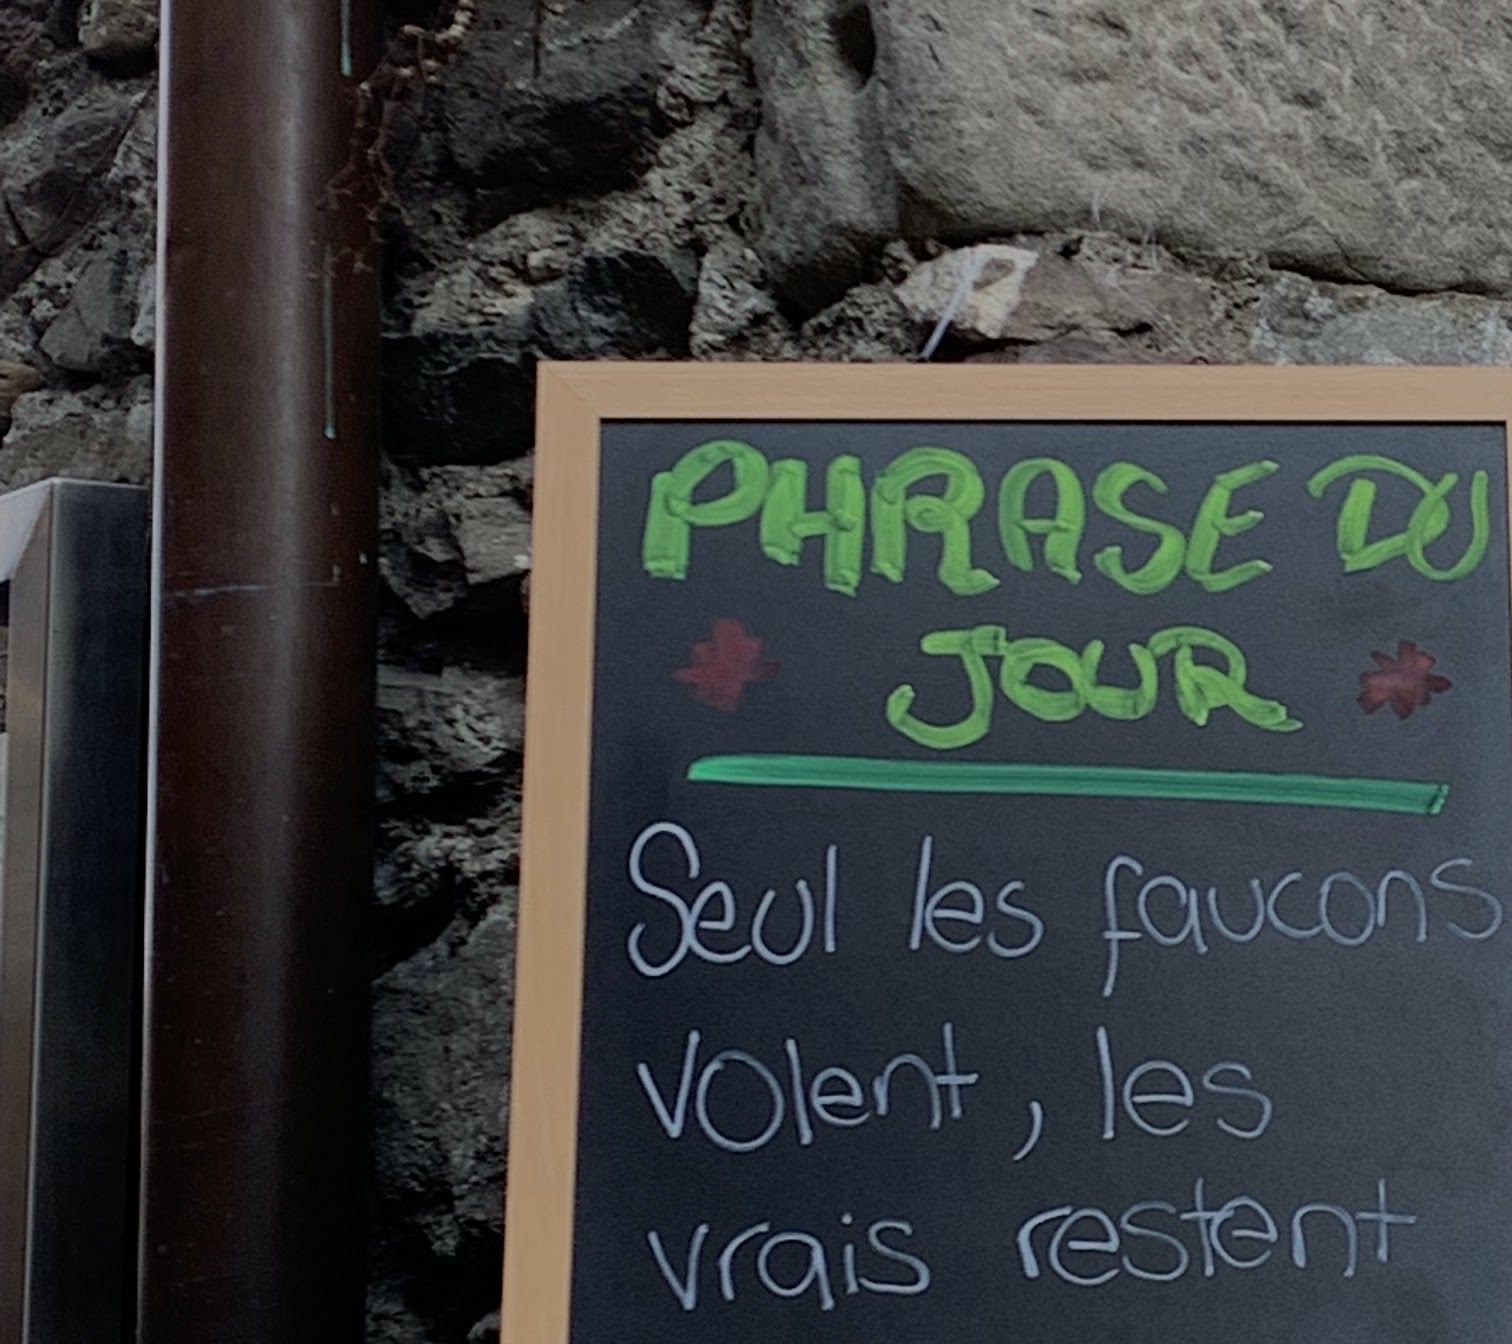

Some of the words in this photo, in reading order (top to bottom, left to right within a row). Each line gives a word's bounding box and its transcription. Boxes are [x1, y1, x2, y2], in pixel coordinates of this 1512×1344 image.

[642, 440, 1279, 596] PHRASE
[1308, 455, 1489, 580] DU
[886, 625, 1304, 749] JOUR
[627, 821, 838, 977] Seul
[909, 835, 1044, 958] les
[1102, 855, 1503, 997] faucons
[1096, 1026, 1273, 1140] les
[648, 1212, 931, 1311] vrais
[1016, 1177, 1417, 1286] restent
